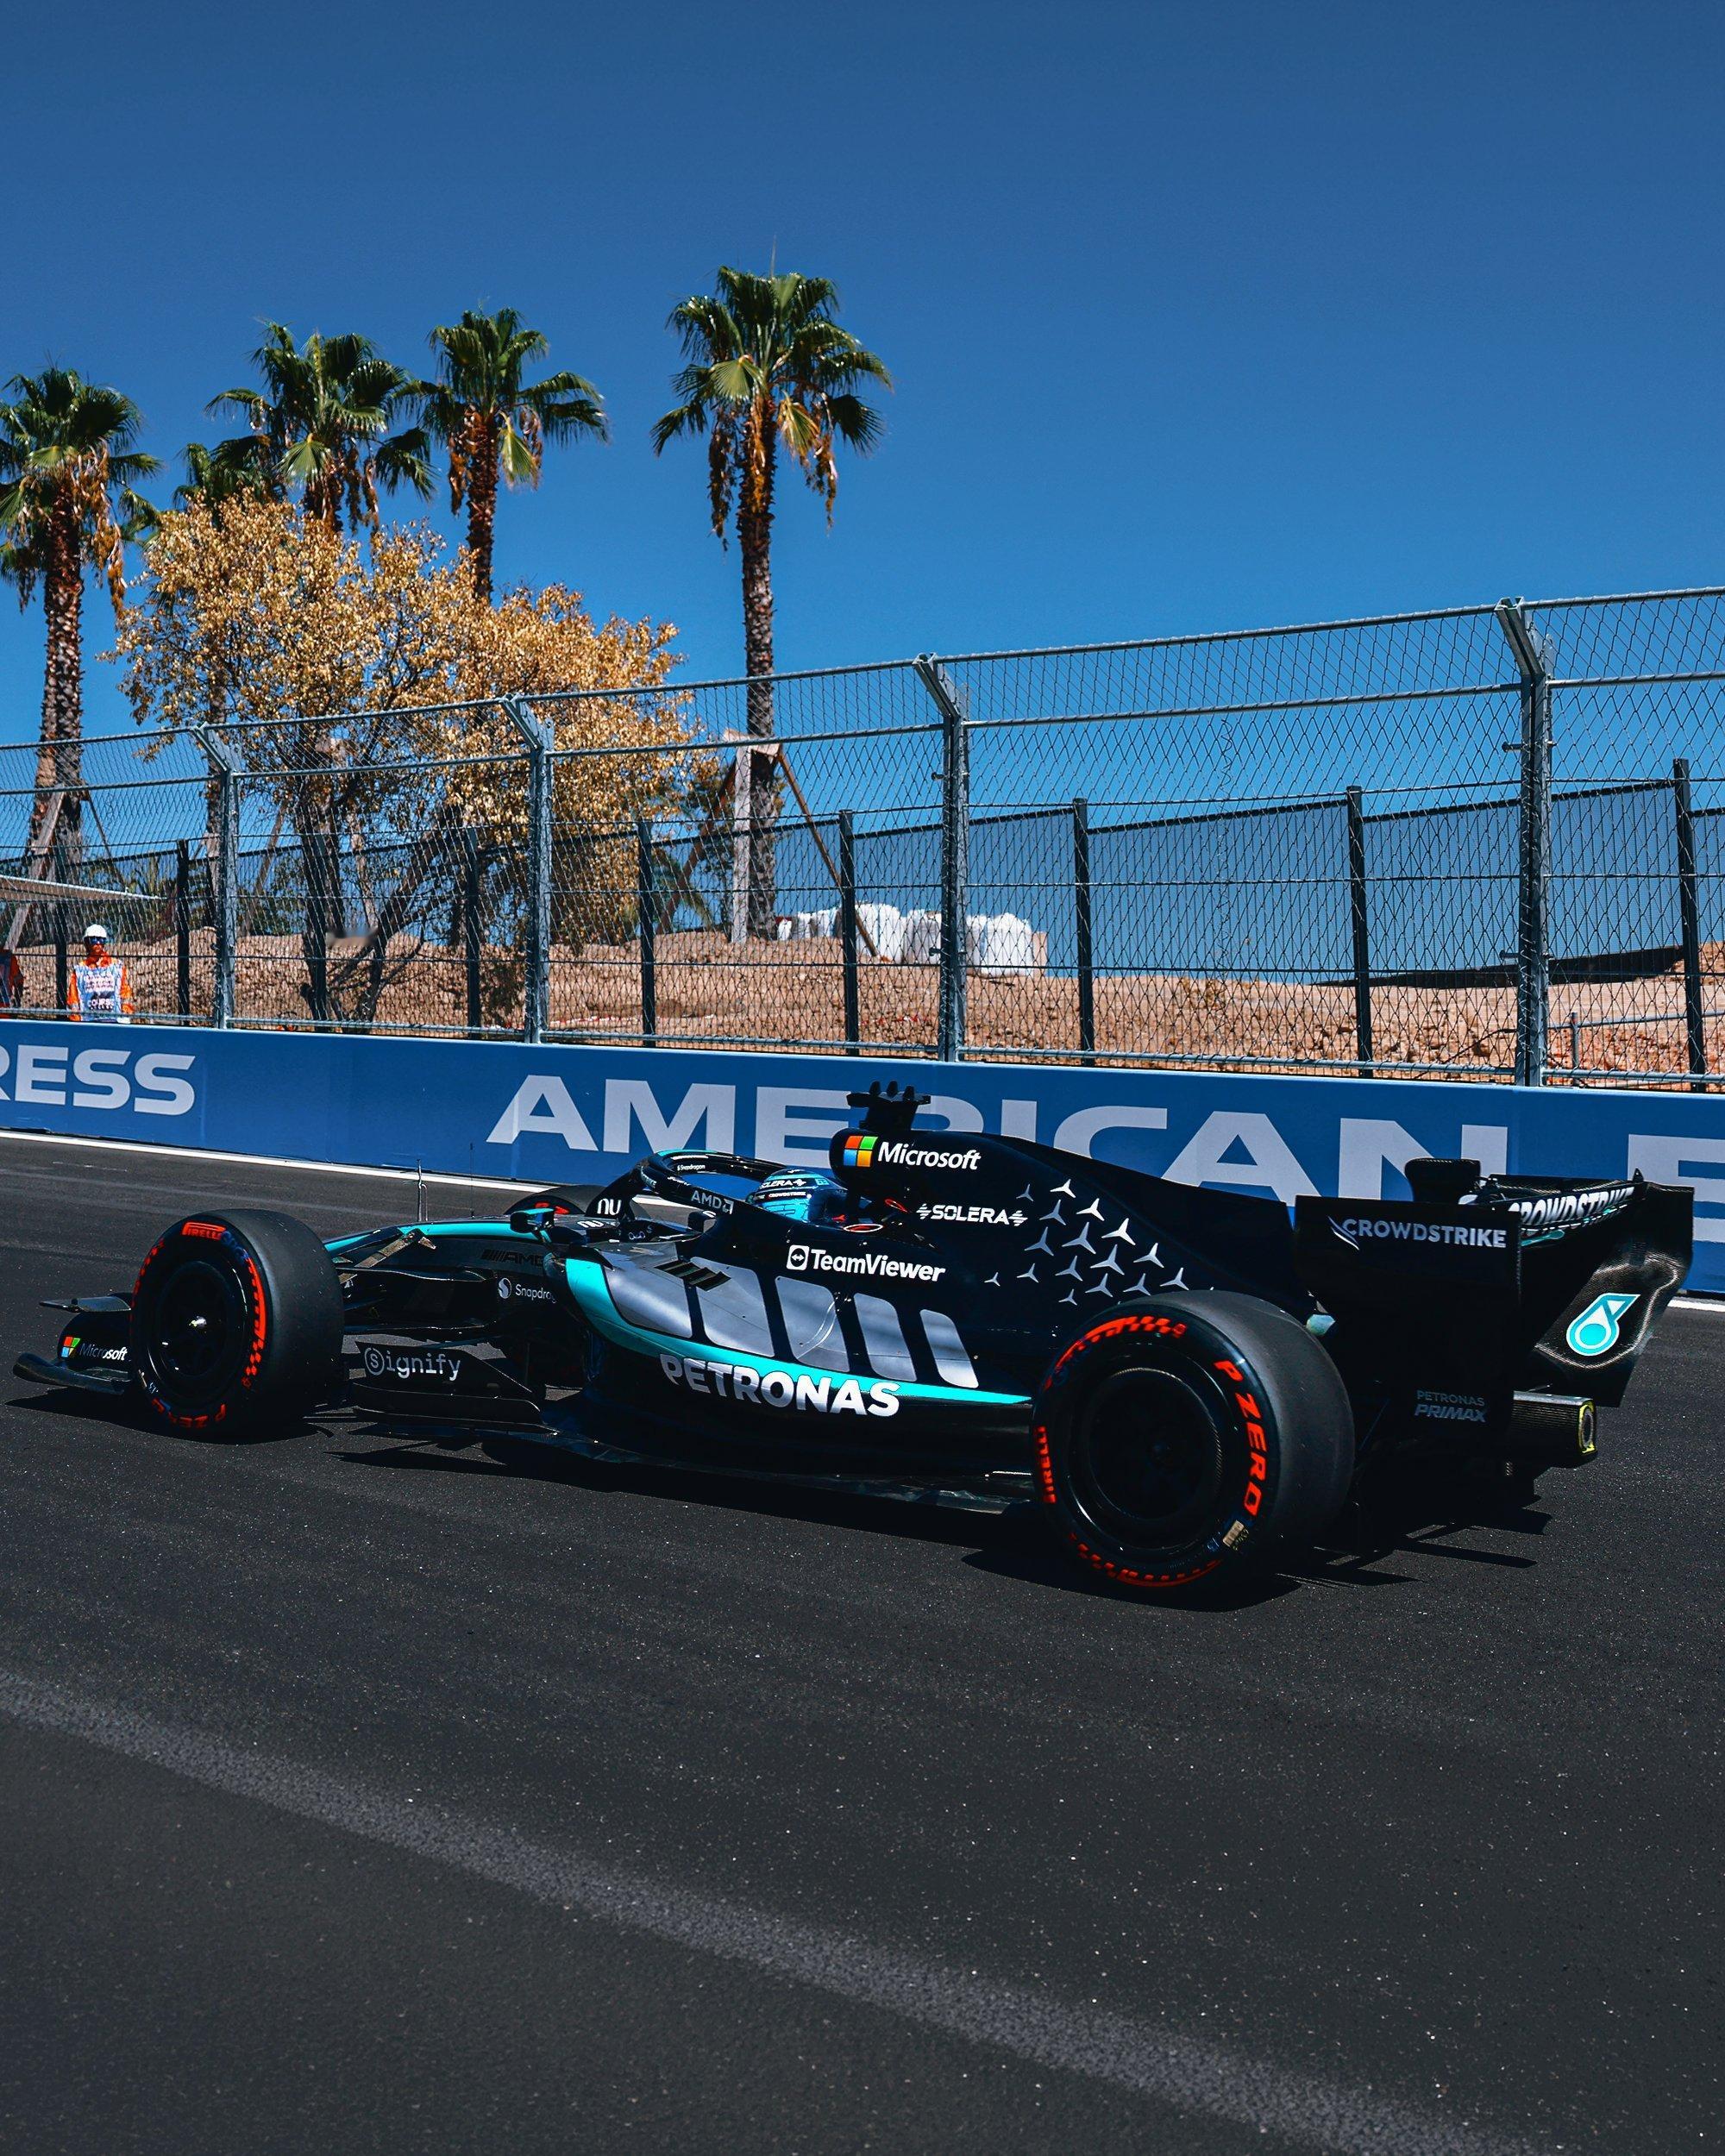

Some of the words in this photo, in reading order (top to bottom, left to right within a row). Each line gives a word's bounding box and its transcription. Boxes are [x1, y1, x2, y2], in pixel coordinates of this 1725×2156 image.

[0, 1044, 196, 1116] ESS
[878, 1141, 981, 1169] Microsoft
[691, 1190, 721, 1209] AMD
[931, 1205, 1010, 1225] SOLERA
[181, 1222, 226, 1241] PIRELLI
[1342, 1219, 1507, 1248] CROWDSTRIKE
[811, 1249, 946, 1282] TeamViewer
[78, 1343, 128, 1361] Microsoft
[660, 1353, 900, 1417] PETRONAS
[1416, 1389, 1485, 1407] PETRONAS
[1414, 1404, 1486, 1423] PRIMAX
[1214, 1360, 1244, 1382] P
[1235, 1393, 1267, 1516] ZERO
